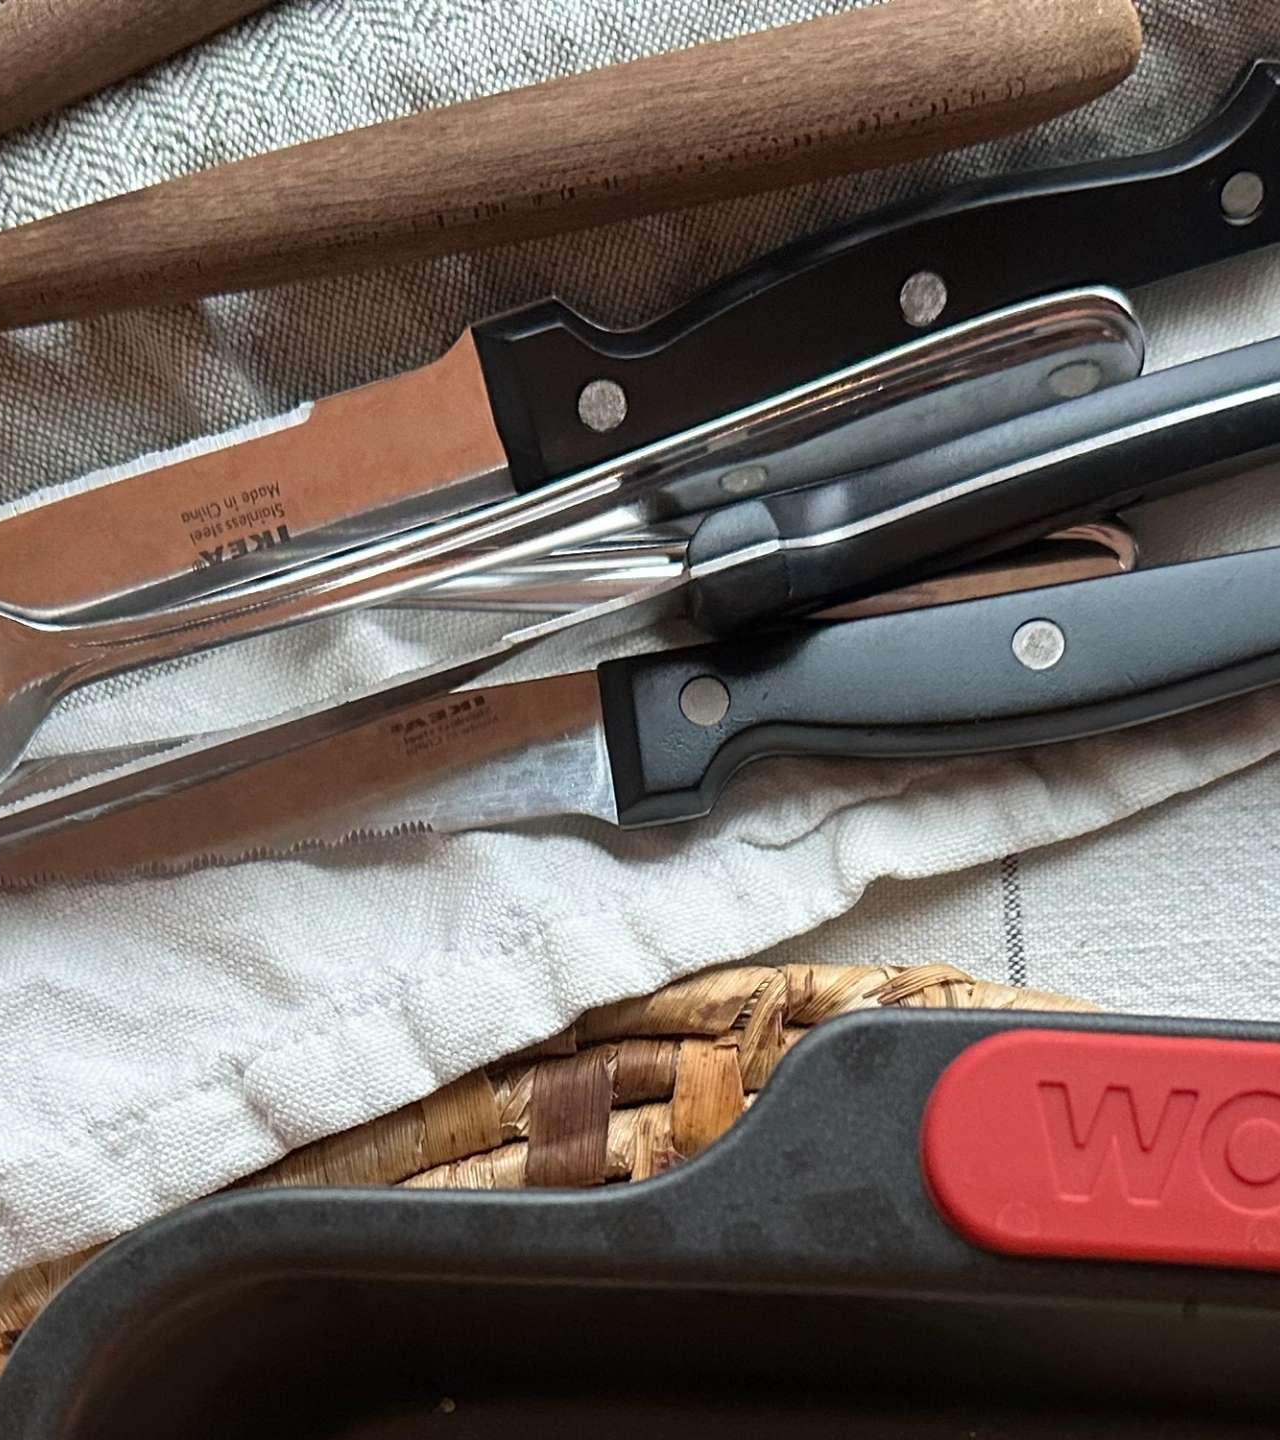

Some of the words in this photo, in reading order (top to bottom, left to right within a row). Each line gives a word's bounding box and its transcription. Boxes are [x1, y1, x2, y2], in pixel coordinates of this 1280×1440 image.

[223, 495, 239, 512] in
[240, 480, 281, 505] Made
[180, 502, 222, 523] China
[225, 503, 286, 530] Stainless
[190, 523, 224, 546] steel
